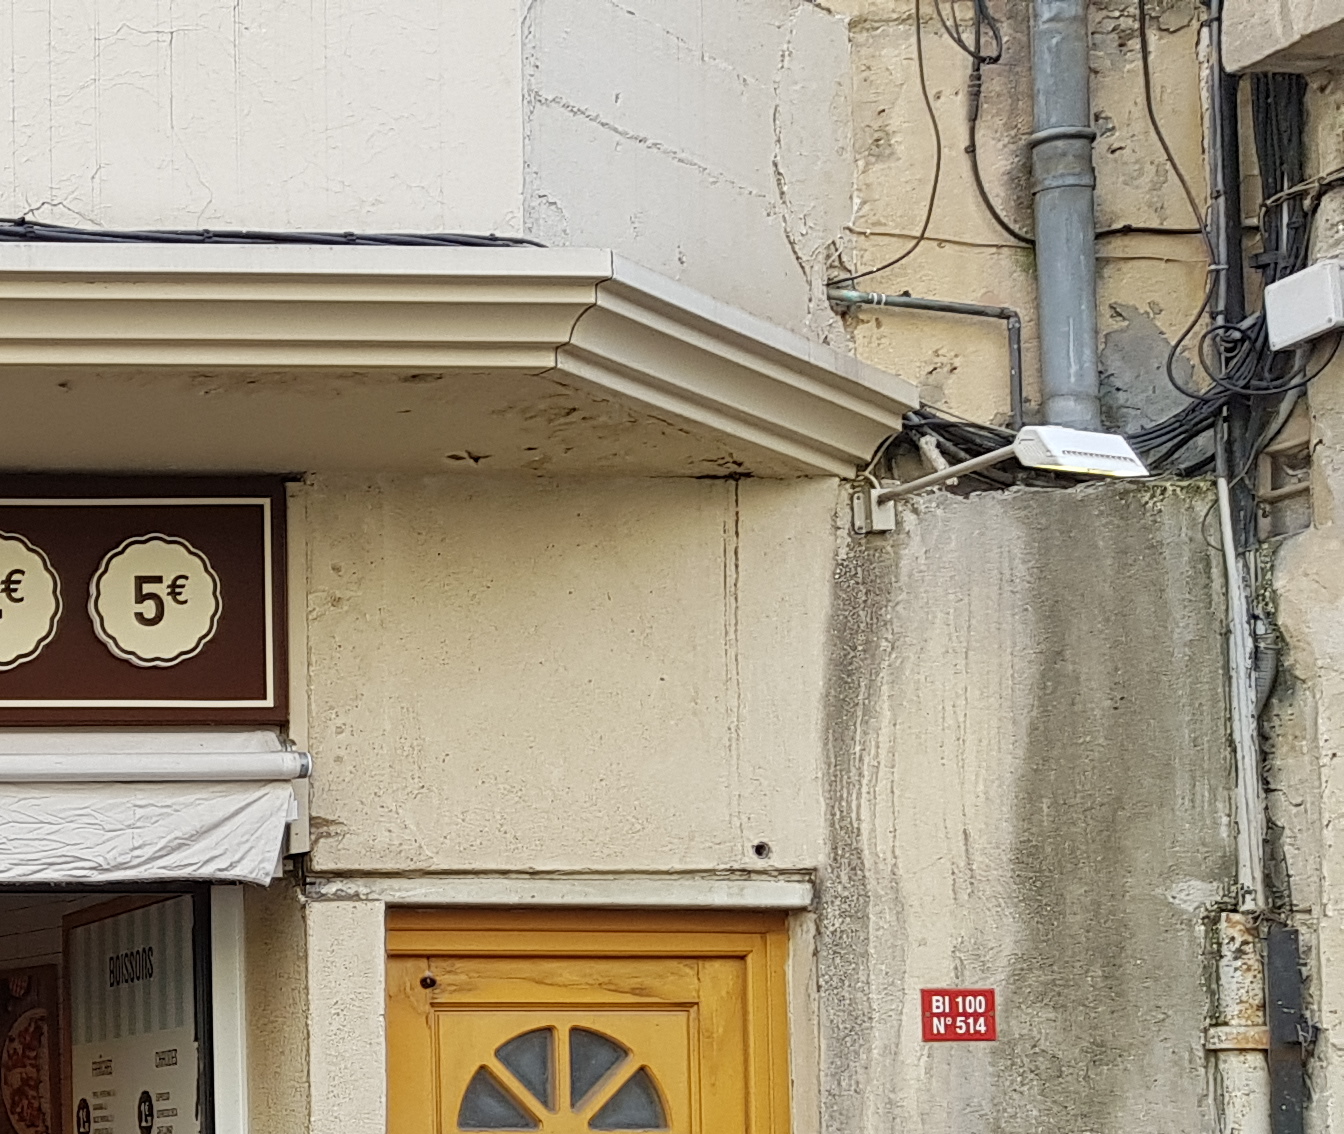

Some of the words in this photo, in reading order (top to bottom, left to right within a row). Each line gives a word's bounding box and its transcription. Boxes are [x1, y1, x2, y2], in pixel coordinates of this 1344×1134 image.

[132, 574, 189, 628] 5€
[109, 946, 154, 987] BOISSONS
[932, 996, 949, 1013] BI
[955, 996, 986, 1013] 100
[933, 1017, 952, 1034] N°
[955, 1017, 986, 1034] 514
